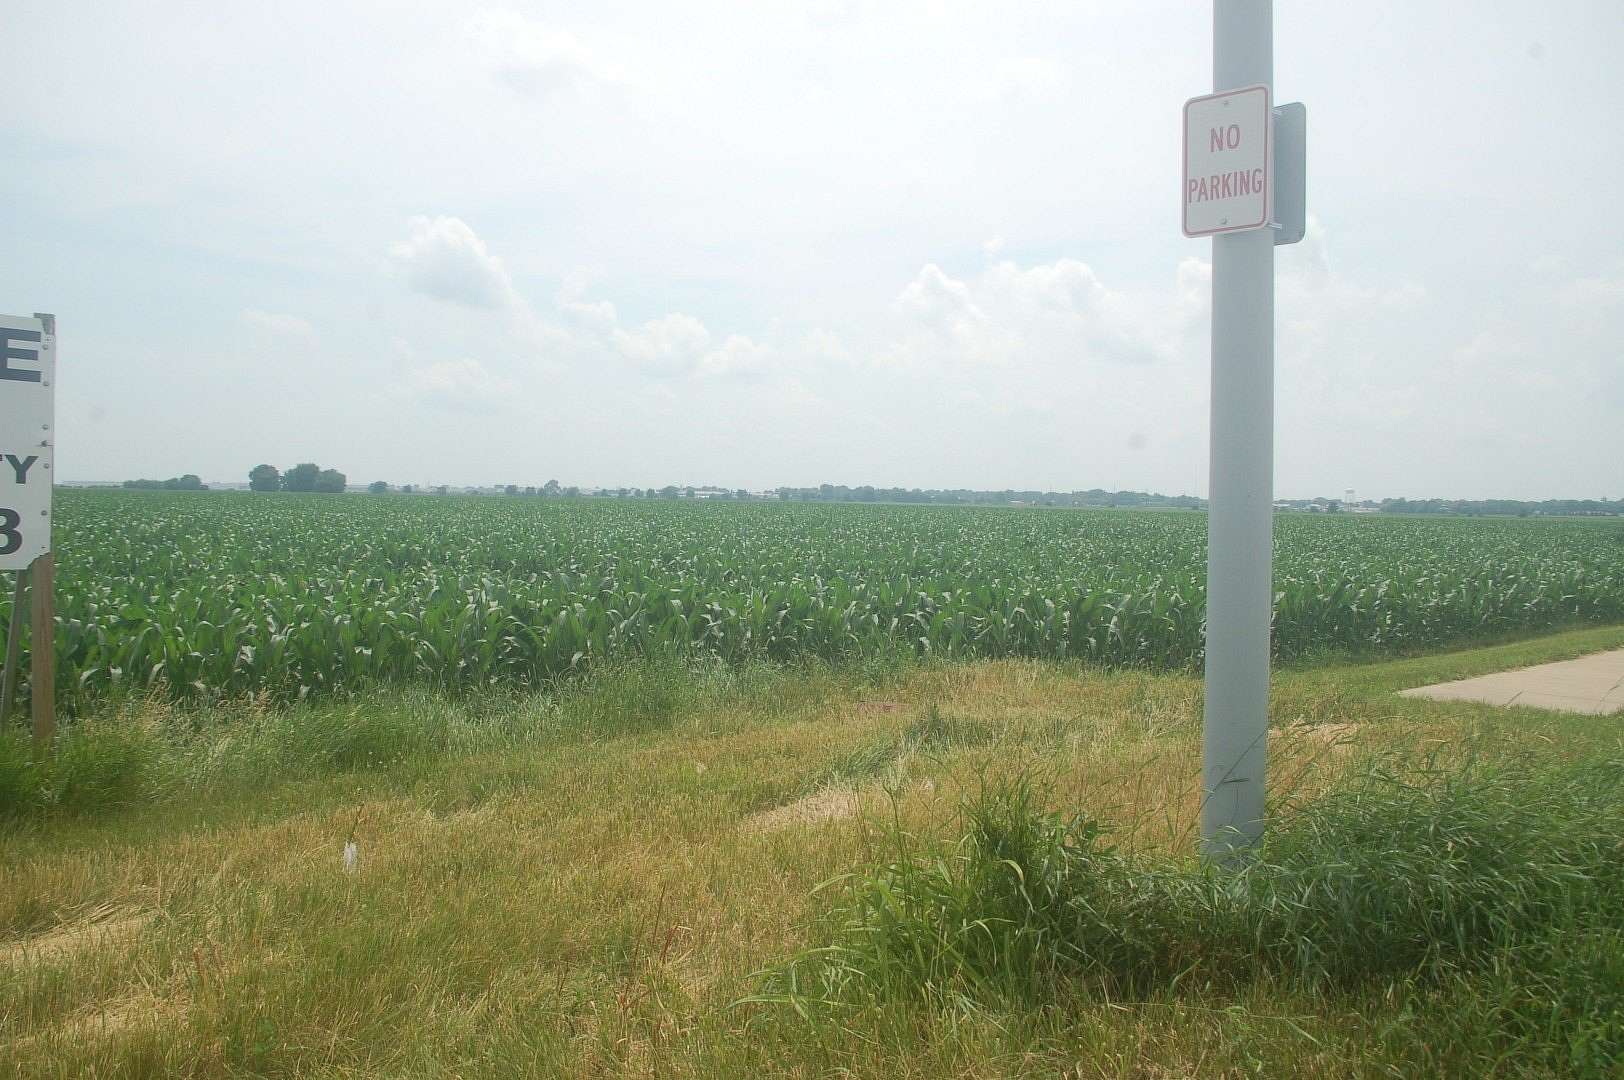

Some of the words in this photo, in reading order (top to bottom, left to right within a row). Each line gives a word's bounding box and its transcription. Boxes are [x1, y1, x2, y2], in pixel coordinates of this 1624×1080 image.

[1210, 123, 1241, 153] NO
[1188, 167, 1263, 204] PARKING
[0, 326, 41, 383] E
[0, 453, 39, 485] Y
